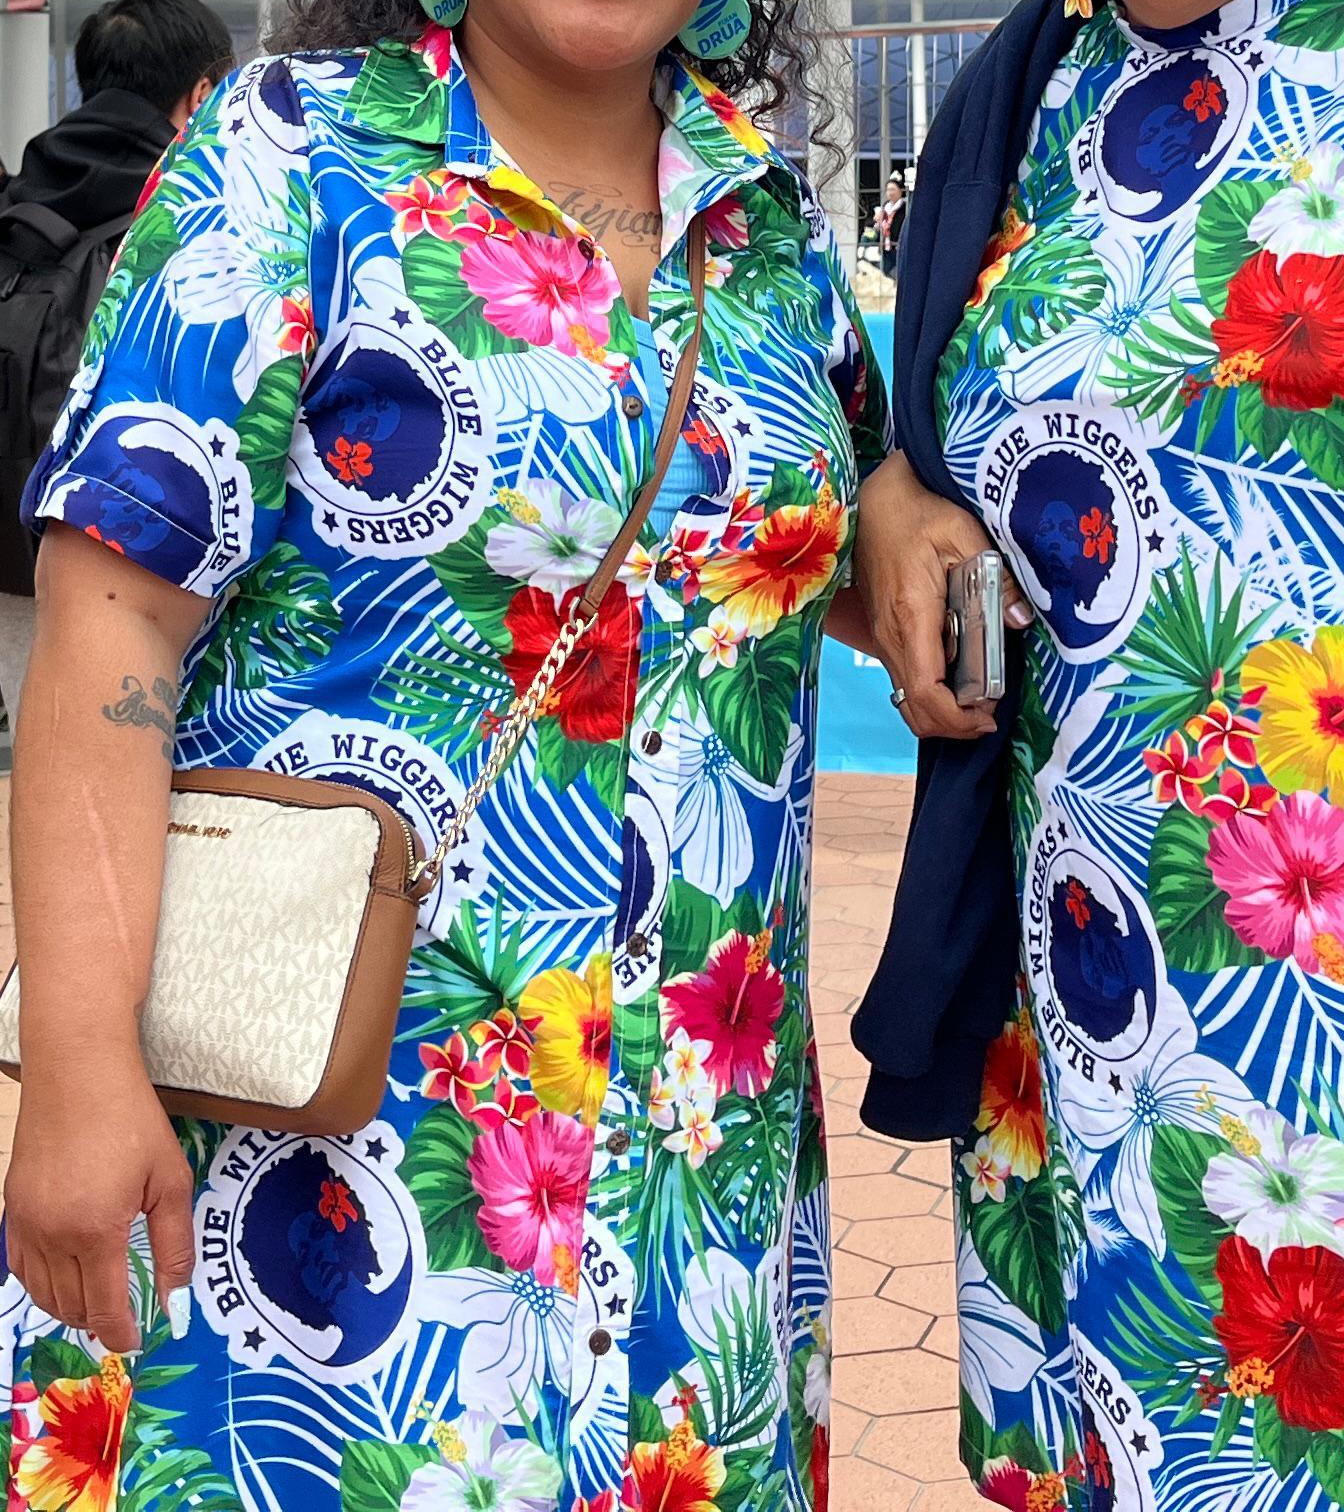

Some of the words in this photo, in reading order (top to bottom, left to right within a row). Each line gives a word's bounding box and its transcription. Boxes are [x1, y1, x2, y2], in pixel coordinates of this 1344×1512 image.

[697, 18, 747, 57] DRUA
[419, 338, 483, 439] BLUE
[349, 459, 480, 546] WIGGERS
[984, 425, 1031, 508] BLUE
[1043, 412, 1161, 521] WIGGERS
[211, 476, 242, 572] BLUE
[1028, 824, 1058, 979] WIGGERS
[1041, 999, 1095, 1083] BLUE
[202, 1207, 245, 1317] BLUE
